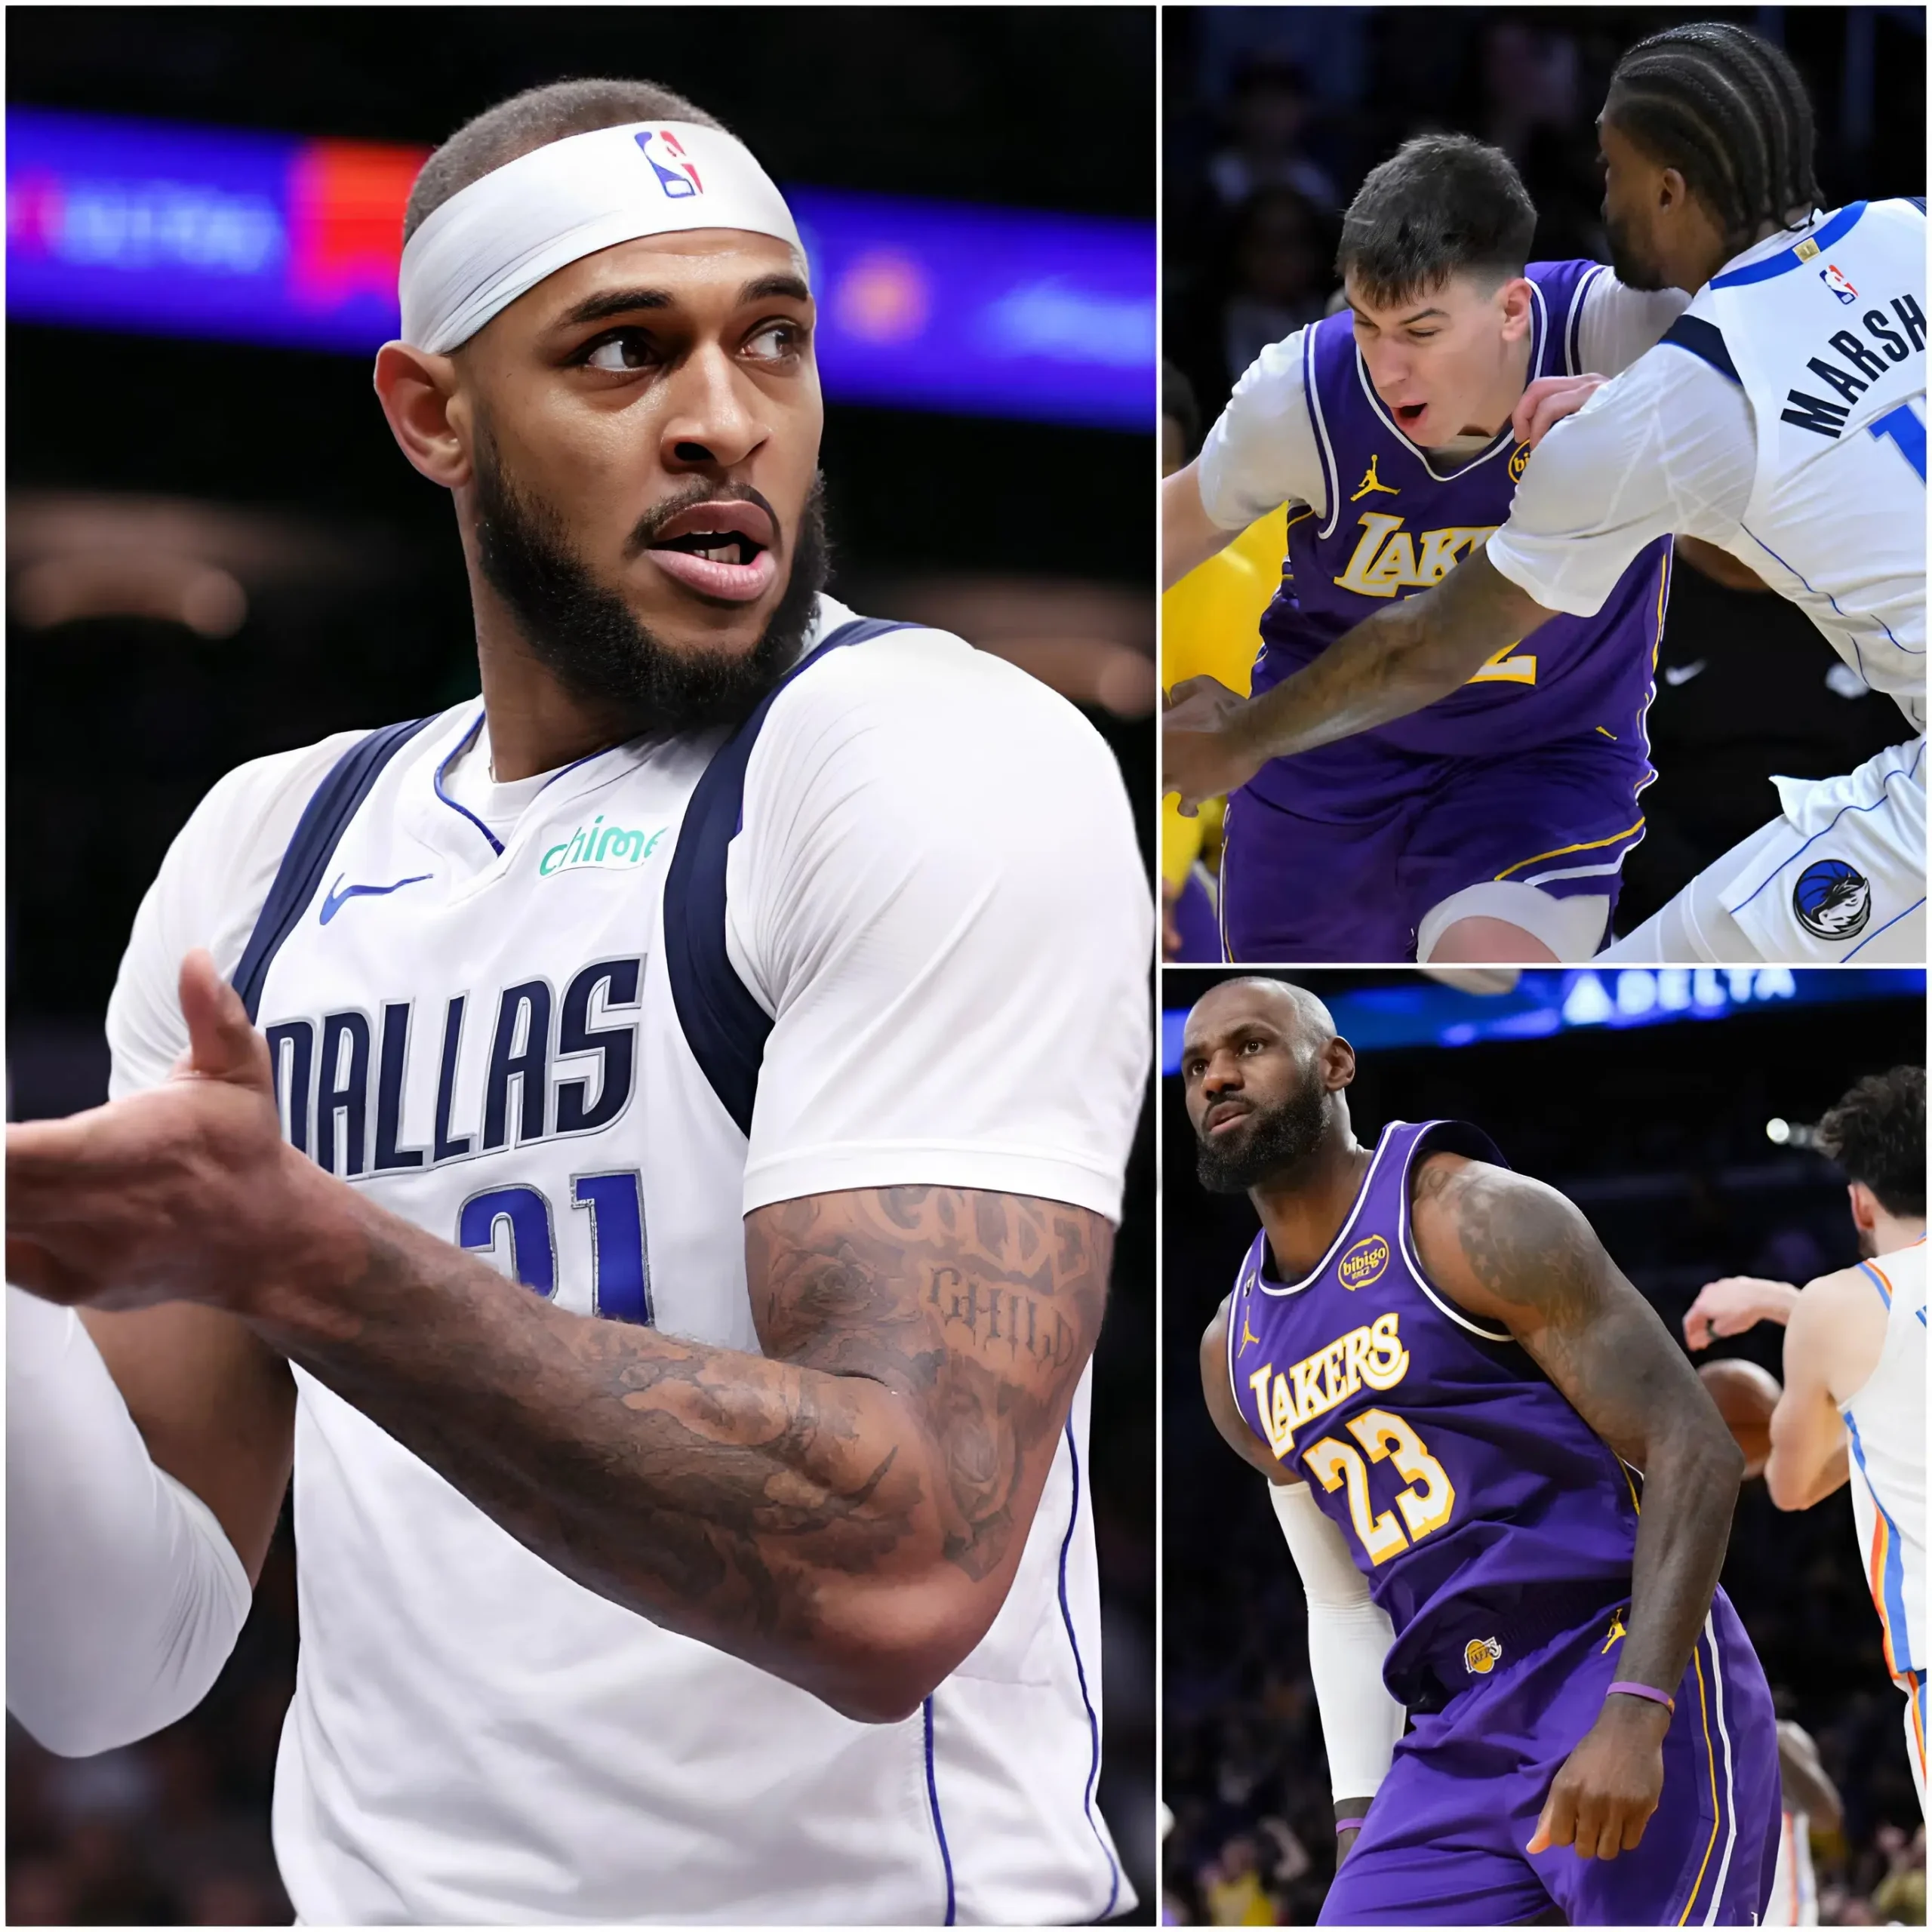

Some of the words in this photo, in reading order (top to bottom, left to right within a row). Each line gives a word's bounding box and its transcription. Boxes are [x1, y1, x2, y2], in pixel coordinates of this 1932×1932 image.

[1334, 512, 1502, 598] LAK
[1617, 968, 1796, 1015] DELTA
[266, 954, 648, 1183] DALLAS
[1343, 1247, 1386, 1275] bibigo
[1250, 1312, 1409, 1460] LAKERS
[1303, 1407, 1456, 1567] 23
